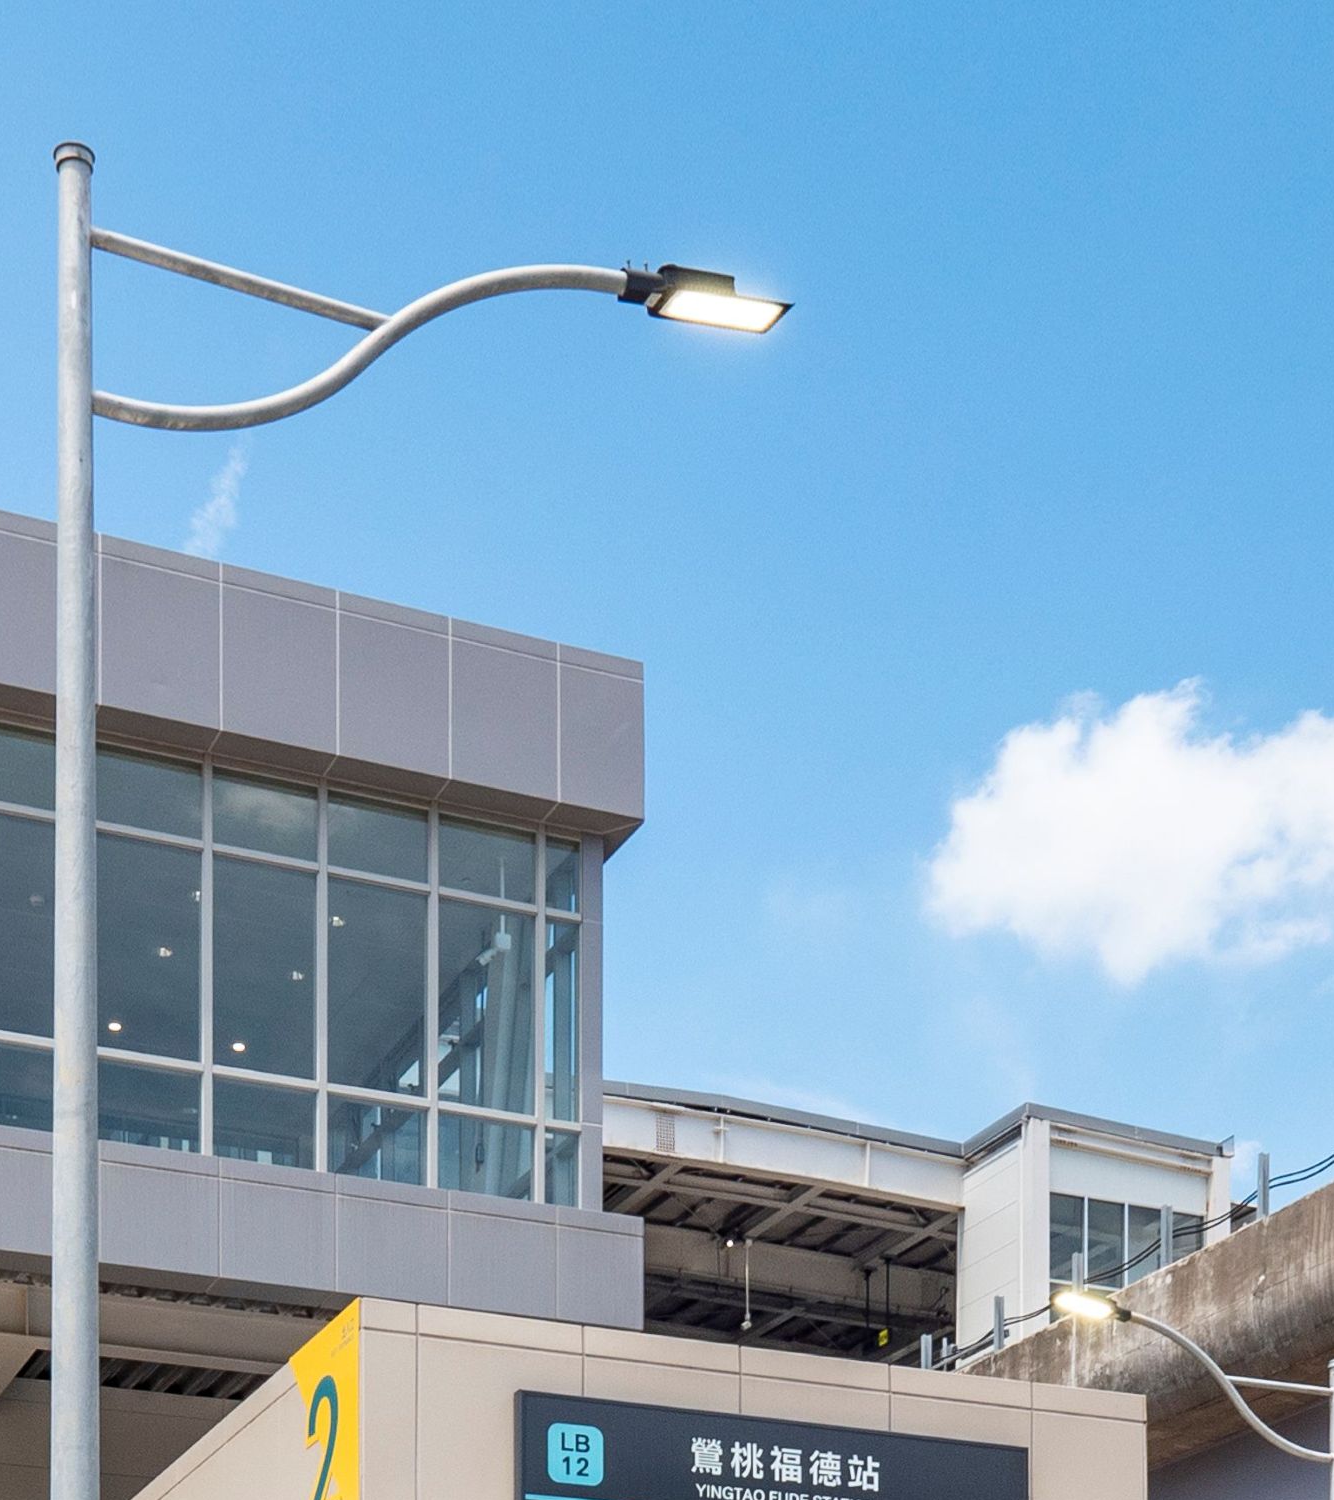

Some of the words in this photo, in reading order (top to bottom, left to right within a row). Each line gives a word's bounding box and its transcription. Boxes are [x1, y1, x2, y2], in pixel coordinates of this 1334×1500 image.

[560, 1432, 591, 1452] LB
[561, 1456, 590, 1477] 12
[690, 1437, 881, 1492] 鶯桃福德站
